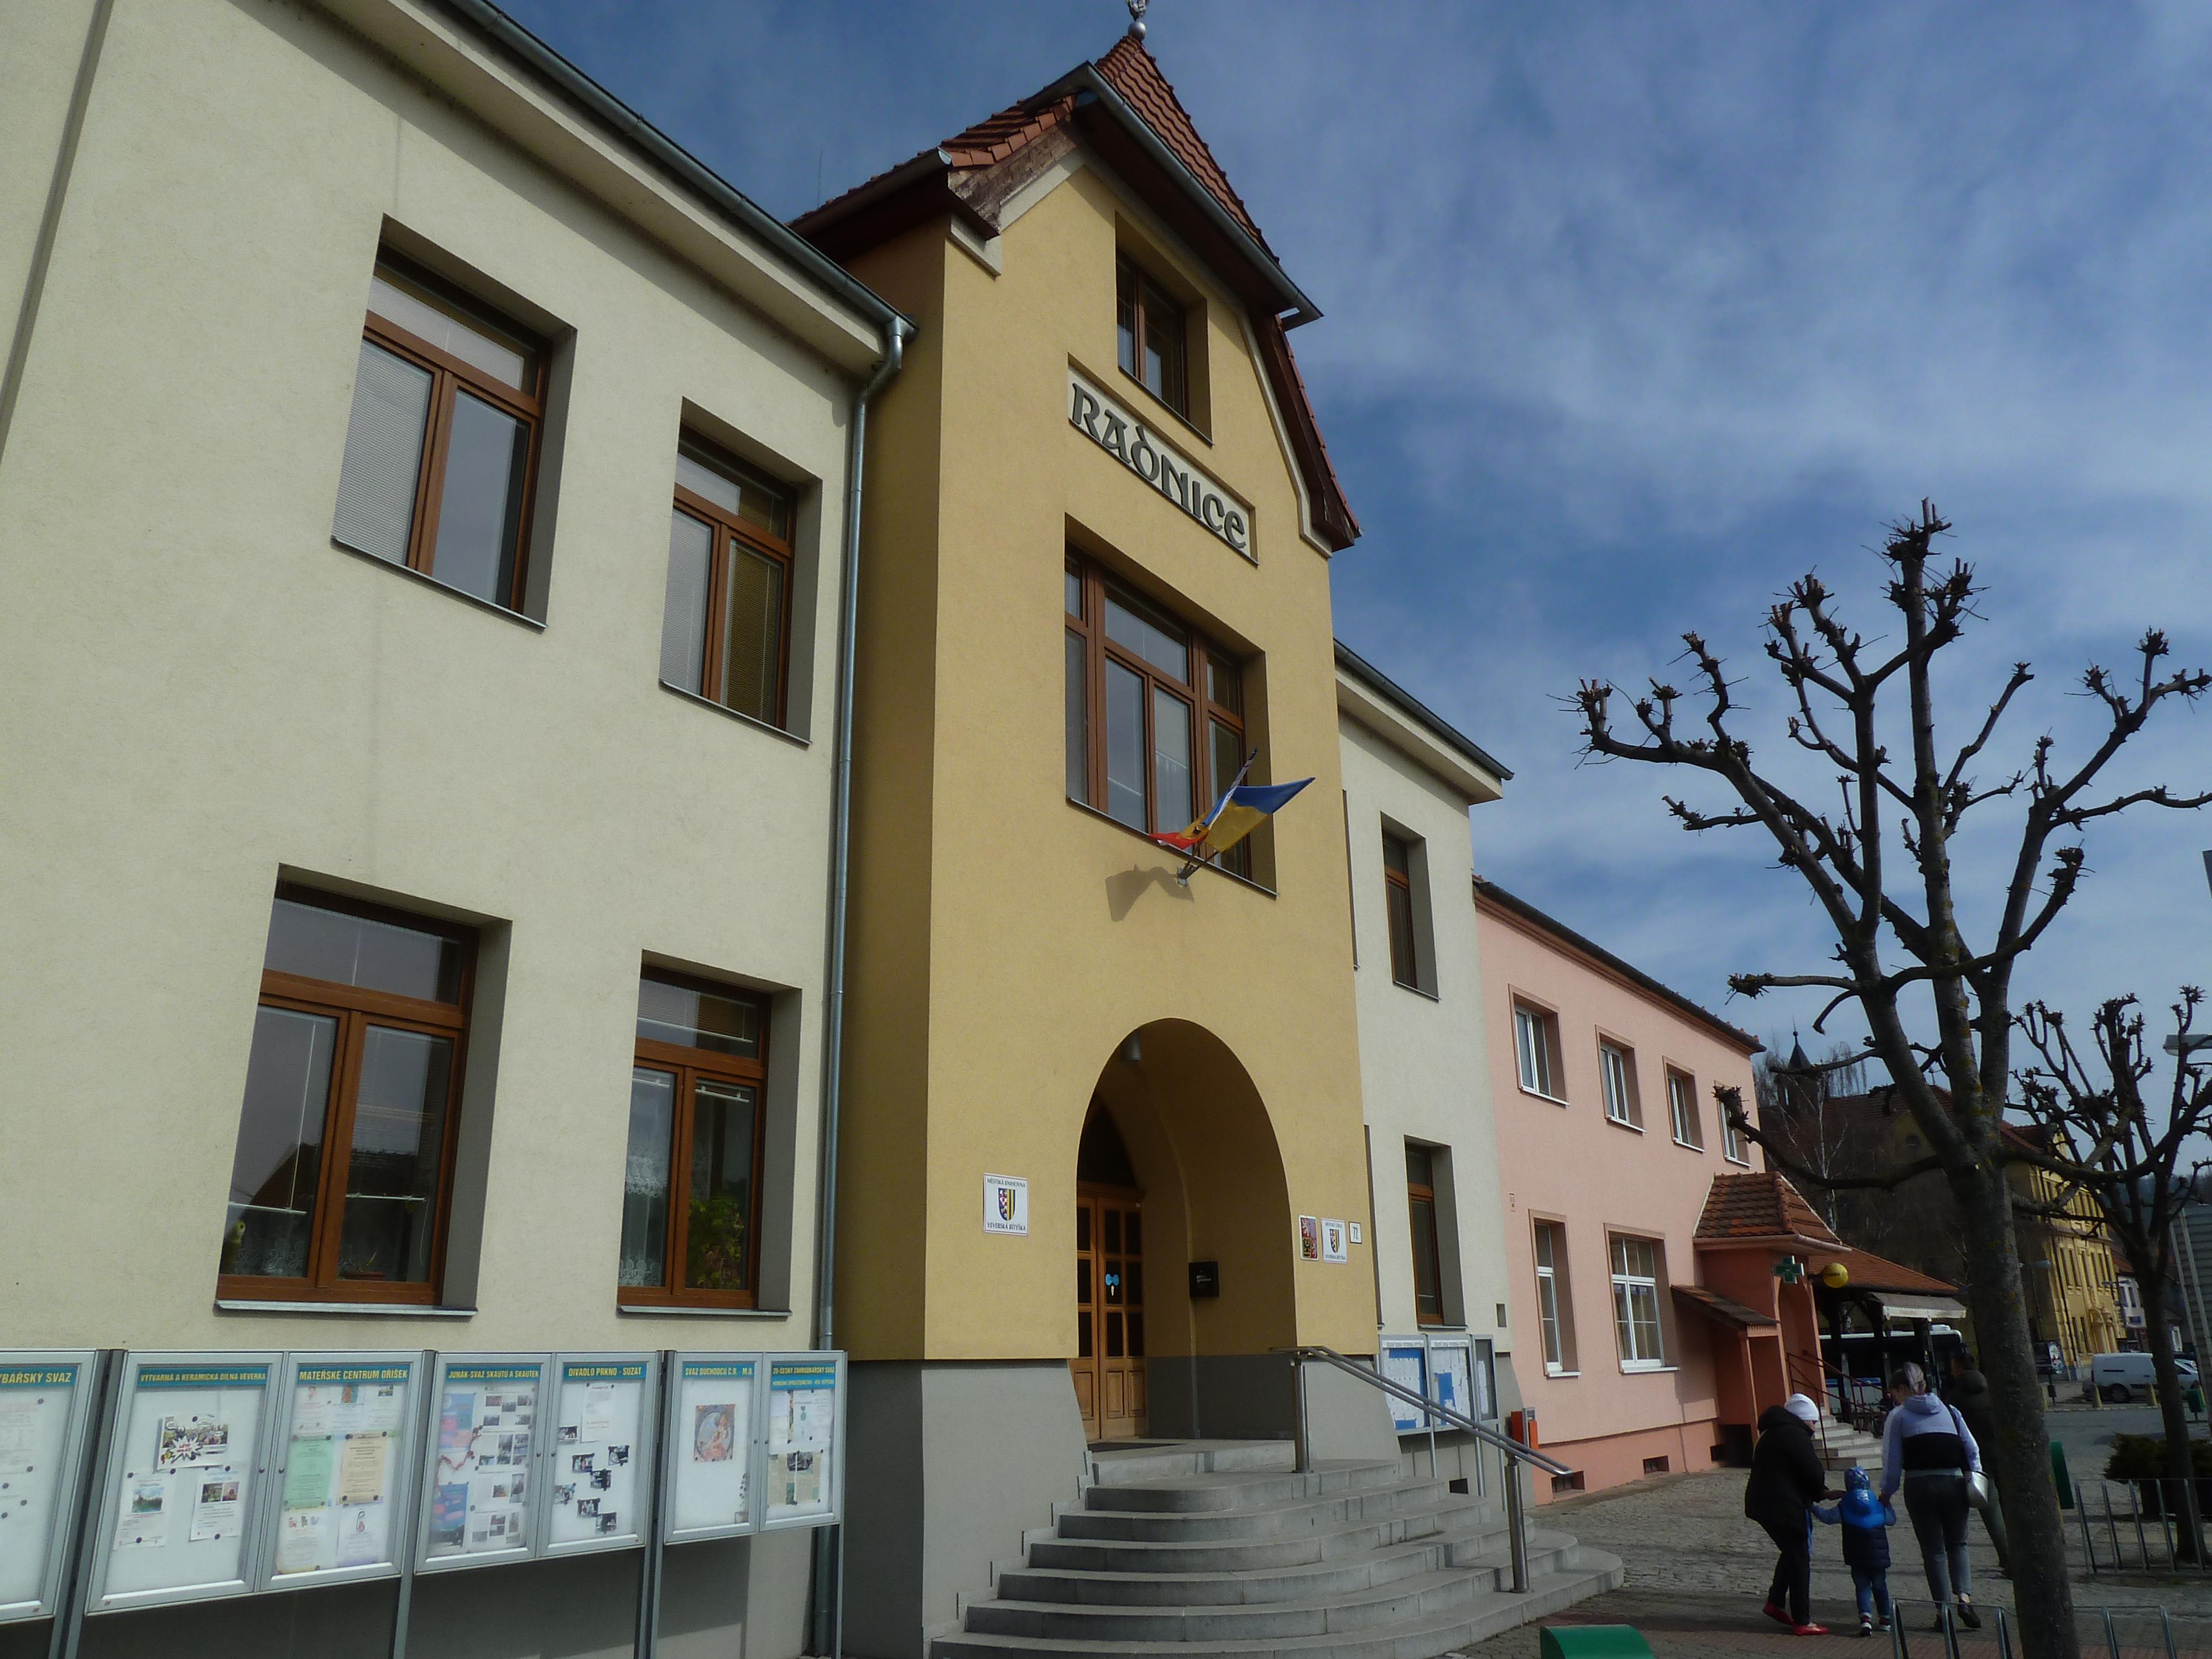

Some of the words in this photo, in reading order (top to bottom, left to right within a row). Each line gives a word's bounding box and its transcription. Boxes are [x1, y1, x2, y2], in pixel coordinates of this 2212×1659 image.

[343, 1369, 379, 1380] CENTRUM
[568, 1368, 595, 1377] DIVADLO
[596, 1368, 618, 1376] PRKNO
[623, 1367, 641, 1375] SUZAT
[685, 1368, 699, 1376] SVAZ
[45, 1372, 72, 1383] SVAZ
